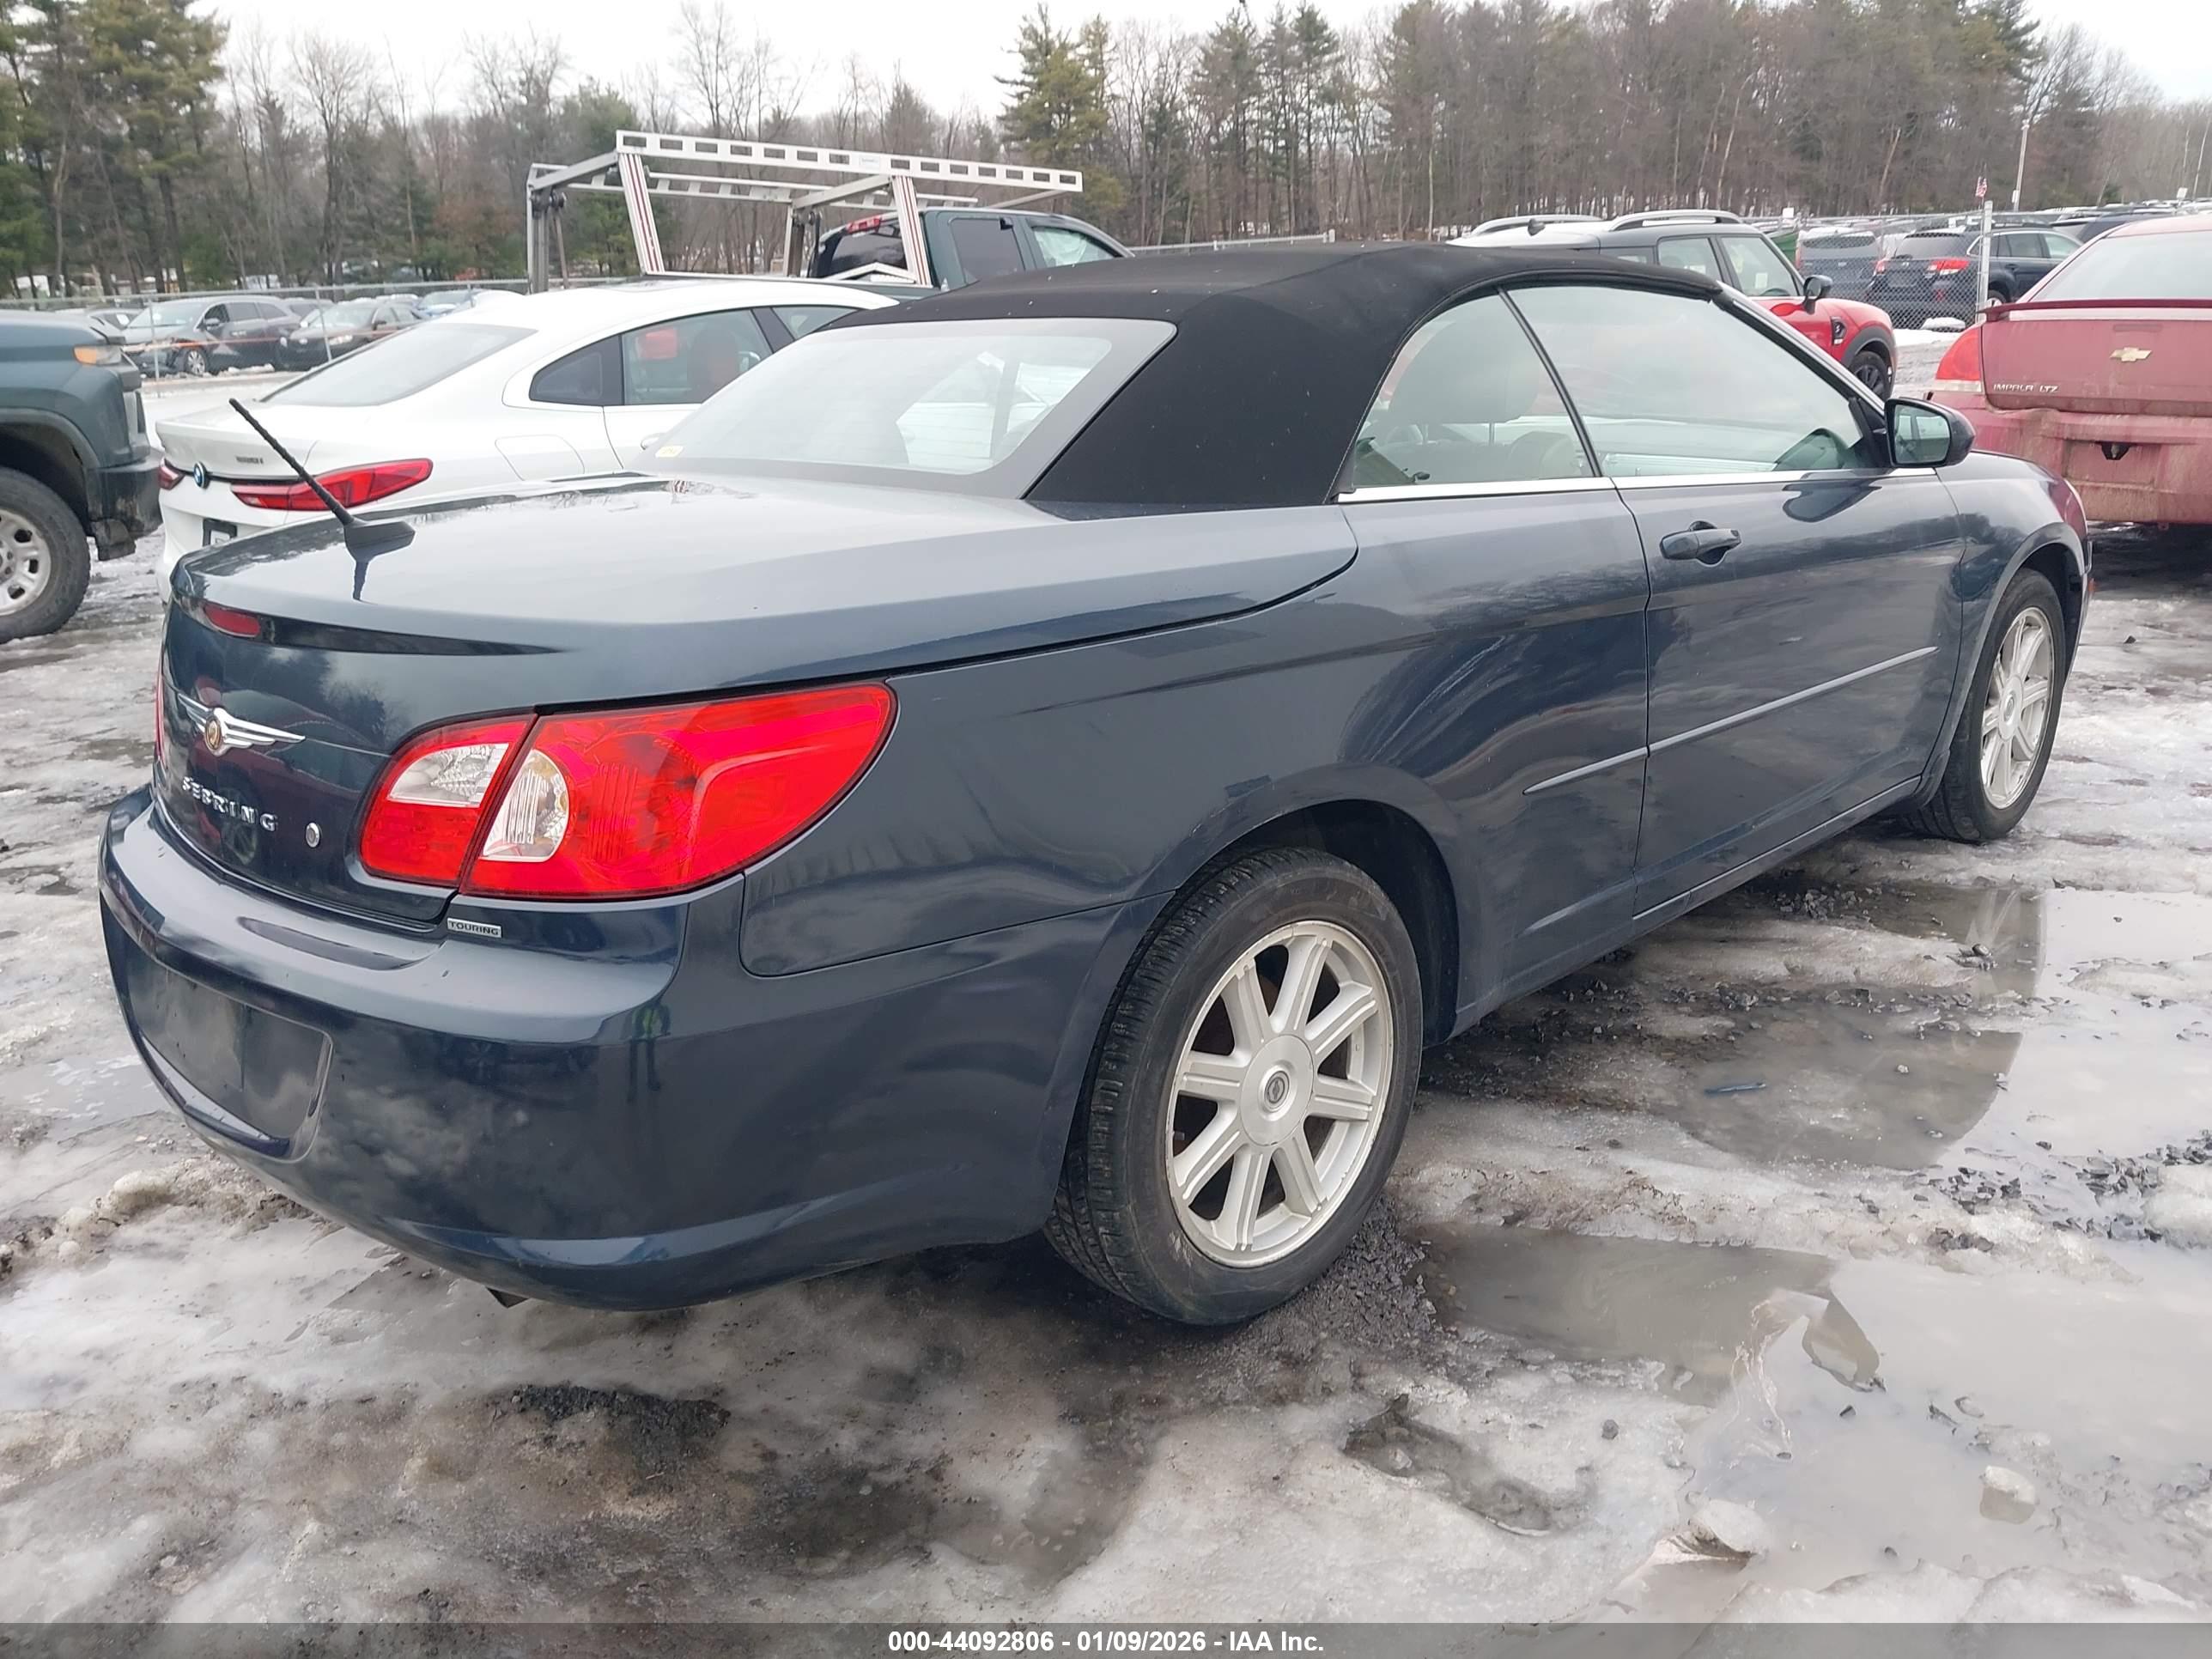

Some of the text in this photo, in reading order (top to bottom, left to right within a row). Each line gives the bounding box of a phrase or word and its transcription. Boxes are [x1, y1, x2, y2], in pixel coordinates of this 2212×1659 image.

[1993, 383, 2058, 393] IMPALA LTZ
[182, 775, 277, 832] SEBRING
[448, 920, 499, 936] TOURING
